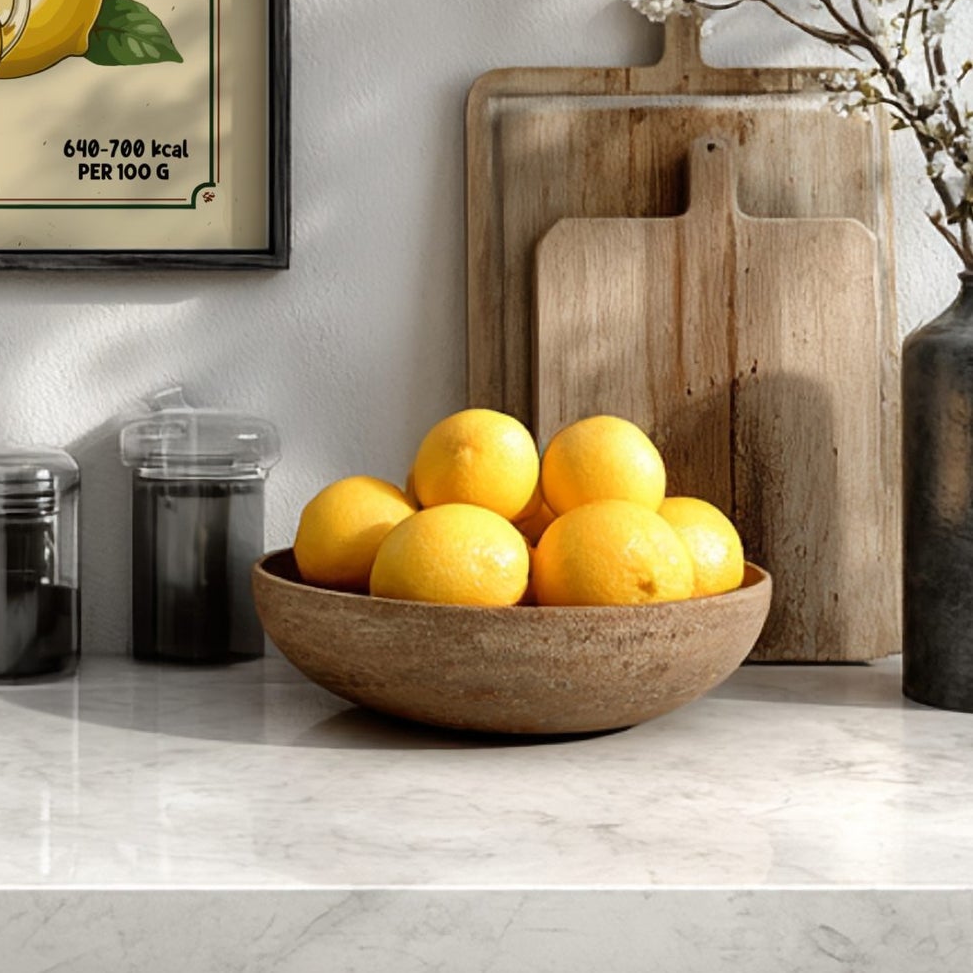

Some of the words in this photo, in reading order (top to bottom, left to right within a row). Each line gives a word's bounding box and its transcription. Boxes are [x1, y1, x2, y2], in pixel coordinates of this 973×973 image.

[64, 139, 145, 158] 640-700
[151, 139, 189, 158] kcal
[78, 163, 112, 180] PER
[117, 163, 151, 180] 100
[156, 163, 169, 180] G
